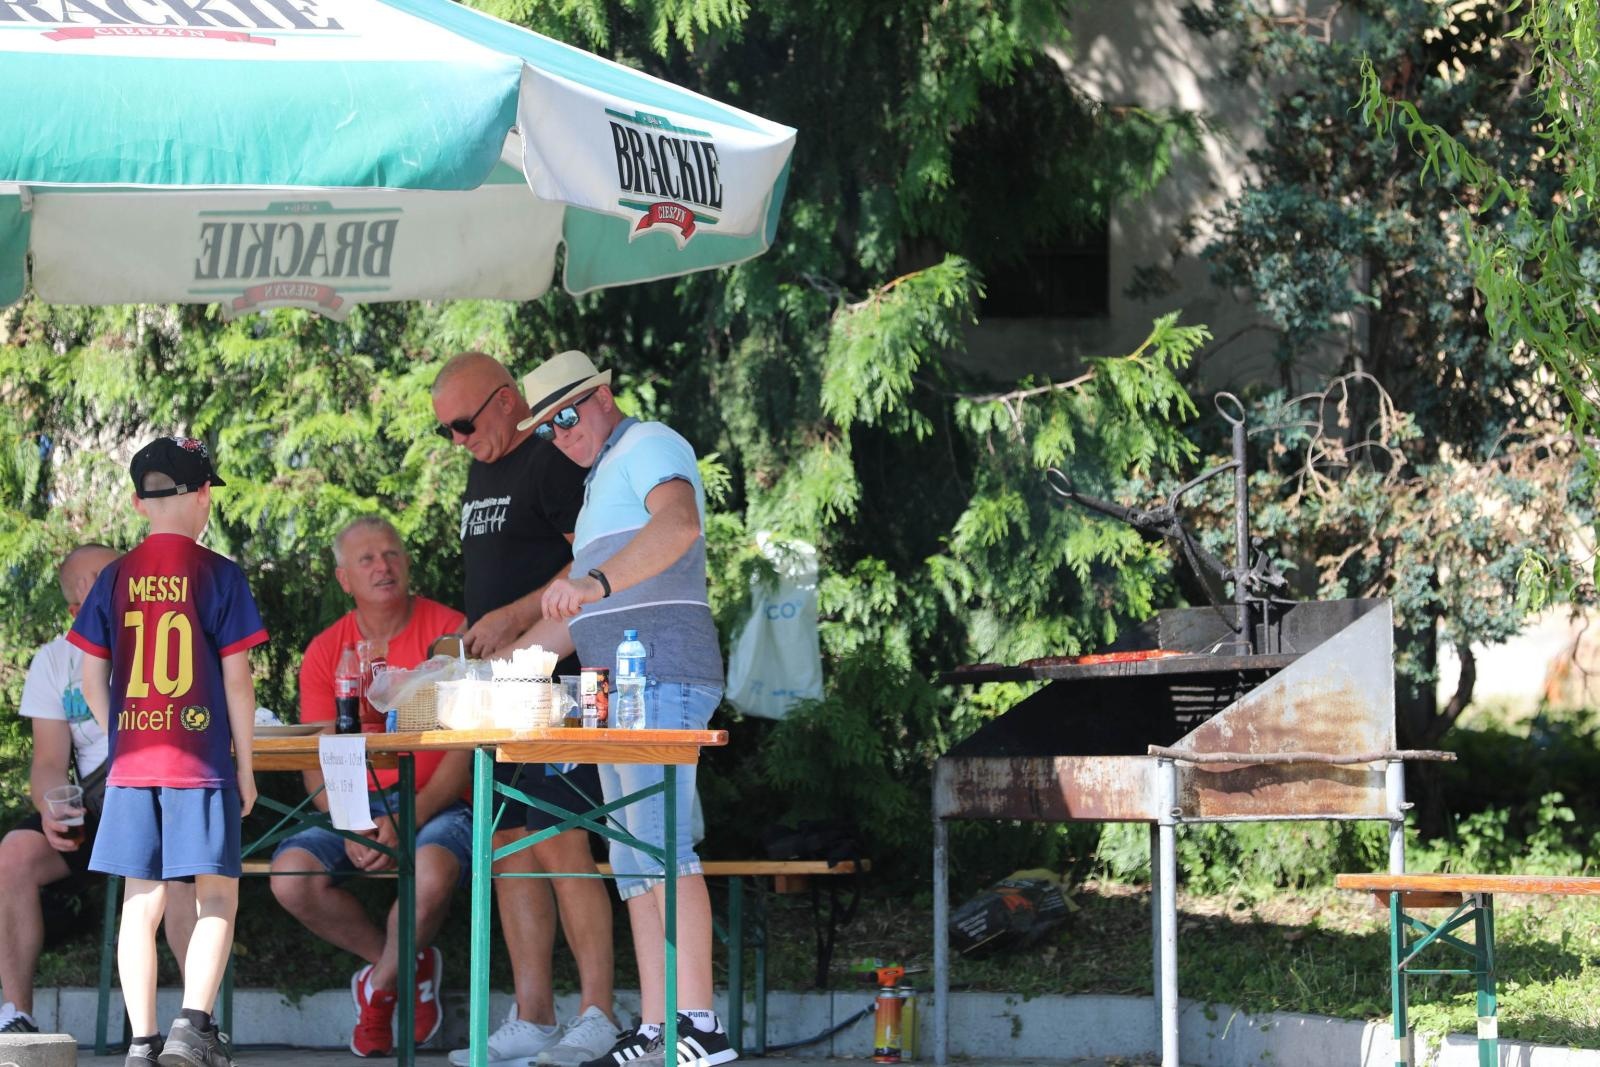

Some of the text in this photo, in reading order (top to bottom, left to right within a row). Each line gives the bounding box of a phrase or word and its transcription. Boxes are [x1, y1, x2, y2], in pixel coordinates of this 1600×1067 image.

[609, 120, 722, 210] BRACKIE
[658, 205, 686, 222] CIESZYN
[128, 575, 188, 603] MESSI
[124, 610, 194, 698] 10
